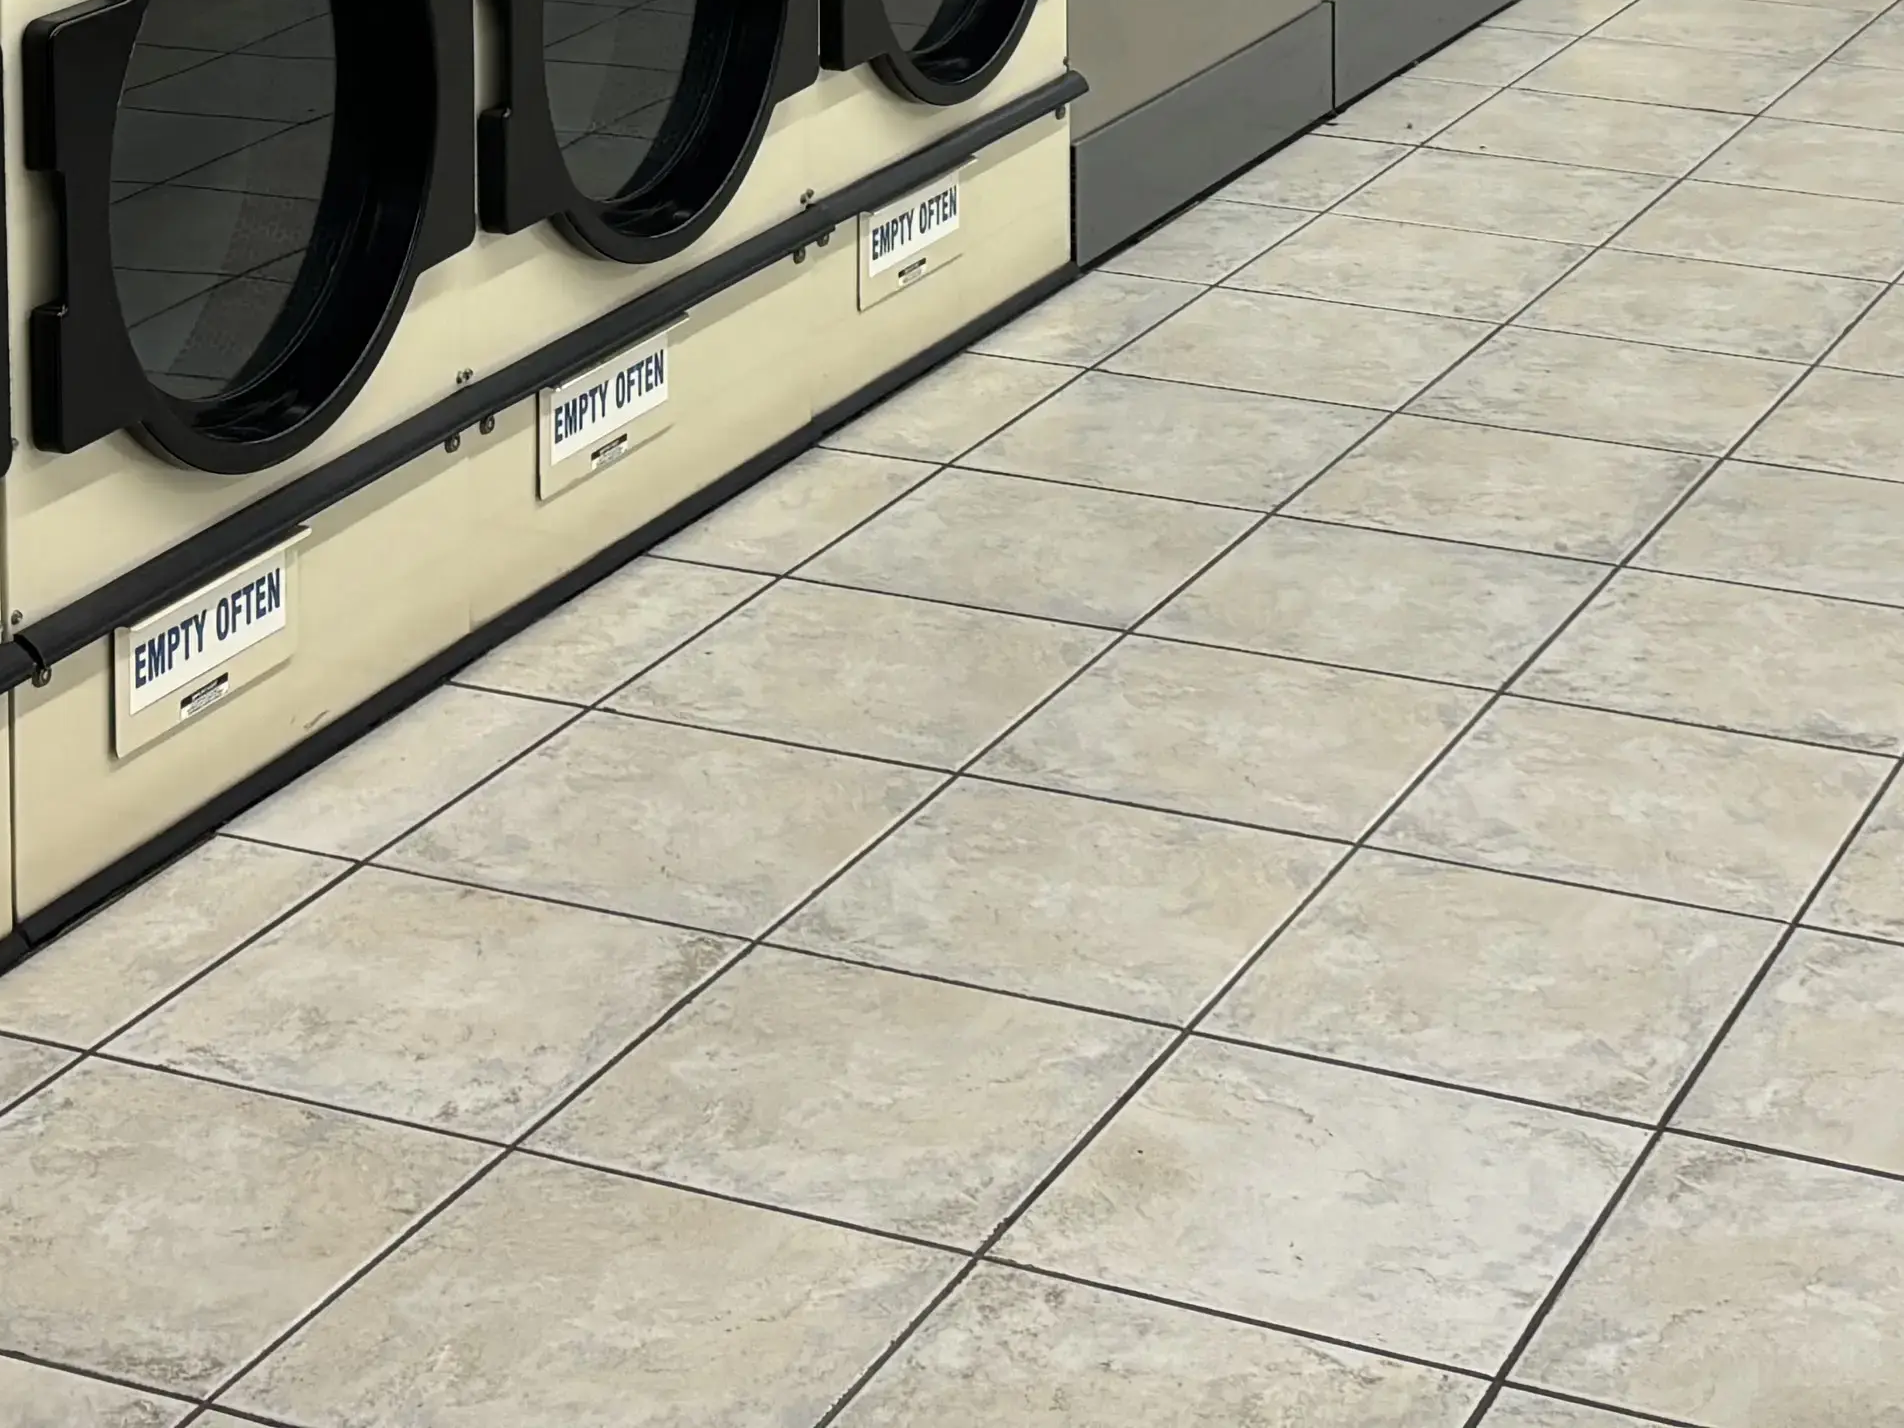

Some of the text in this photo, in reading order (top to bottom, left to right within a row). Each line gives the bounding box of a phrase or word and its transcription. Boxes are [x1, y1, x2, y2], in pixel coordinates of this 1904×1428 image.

[872, 184, 957, 261] EMPTY OFTEN
[554, 349, 664, 445] EMPTY OFTEN
[134, 567, 280, 689] EMPTY OFTEN
